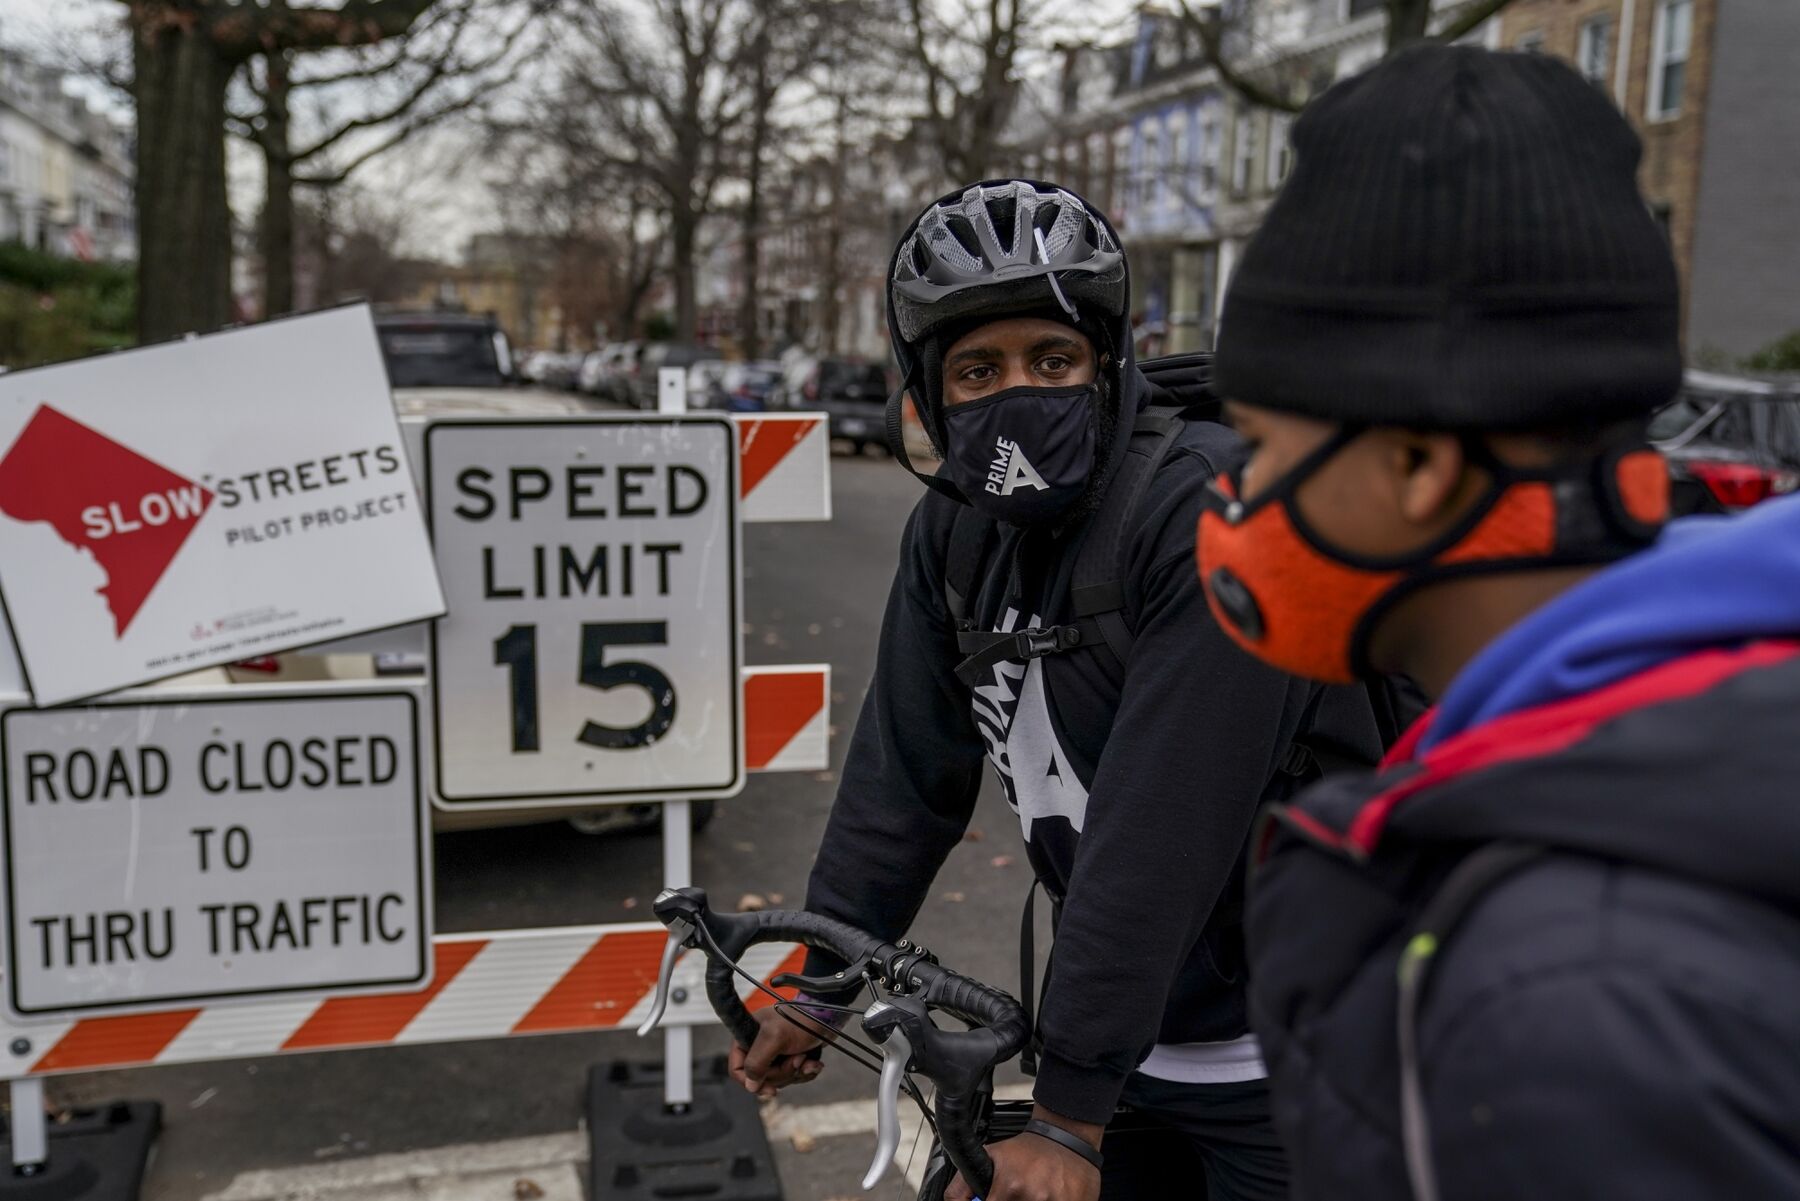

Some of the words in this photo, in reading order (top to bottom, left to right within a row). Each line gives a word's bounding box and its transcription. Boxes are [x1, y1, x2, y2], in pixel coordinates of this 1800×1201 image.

[81, 480, 205, 540] SLOW
[216, 446, 400, 508] STREETS
[454, 465, 708, 522] SPEED
[984, 436, 1015, 496] PRIME
[1000, 442, 1050, 496] A
[226, 518, 296, 546] PILOT
[301, 494, 407, 531] PROJECT
[482, 543, 683, 599] LIMIT
[493, 619, 678, 754] 15
[24, 746, 170, 804] ROAD
[200, 736, 398, 794] CLOSED
[190, 825, 251, 872] TO
[30, 907, 174, 969] THRU
[199, 893, 406, 955] TRAFFIC
